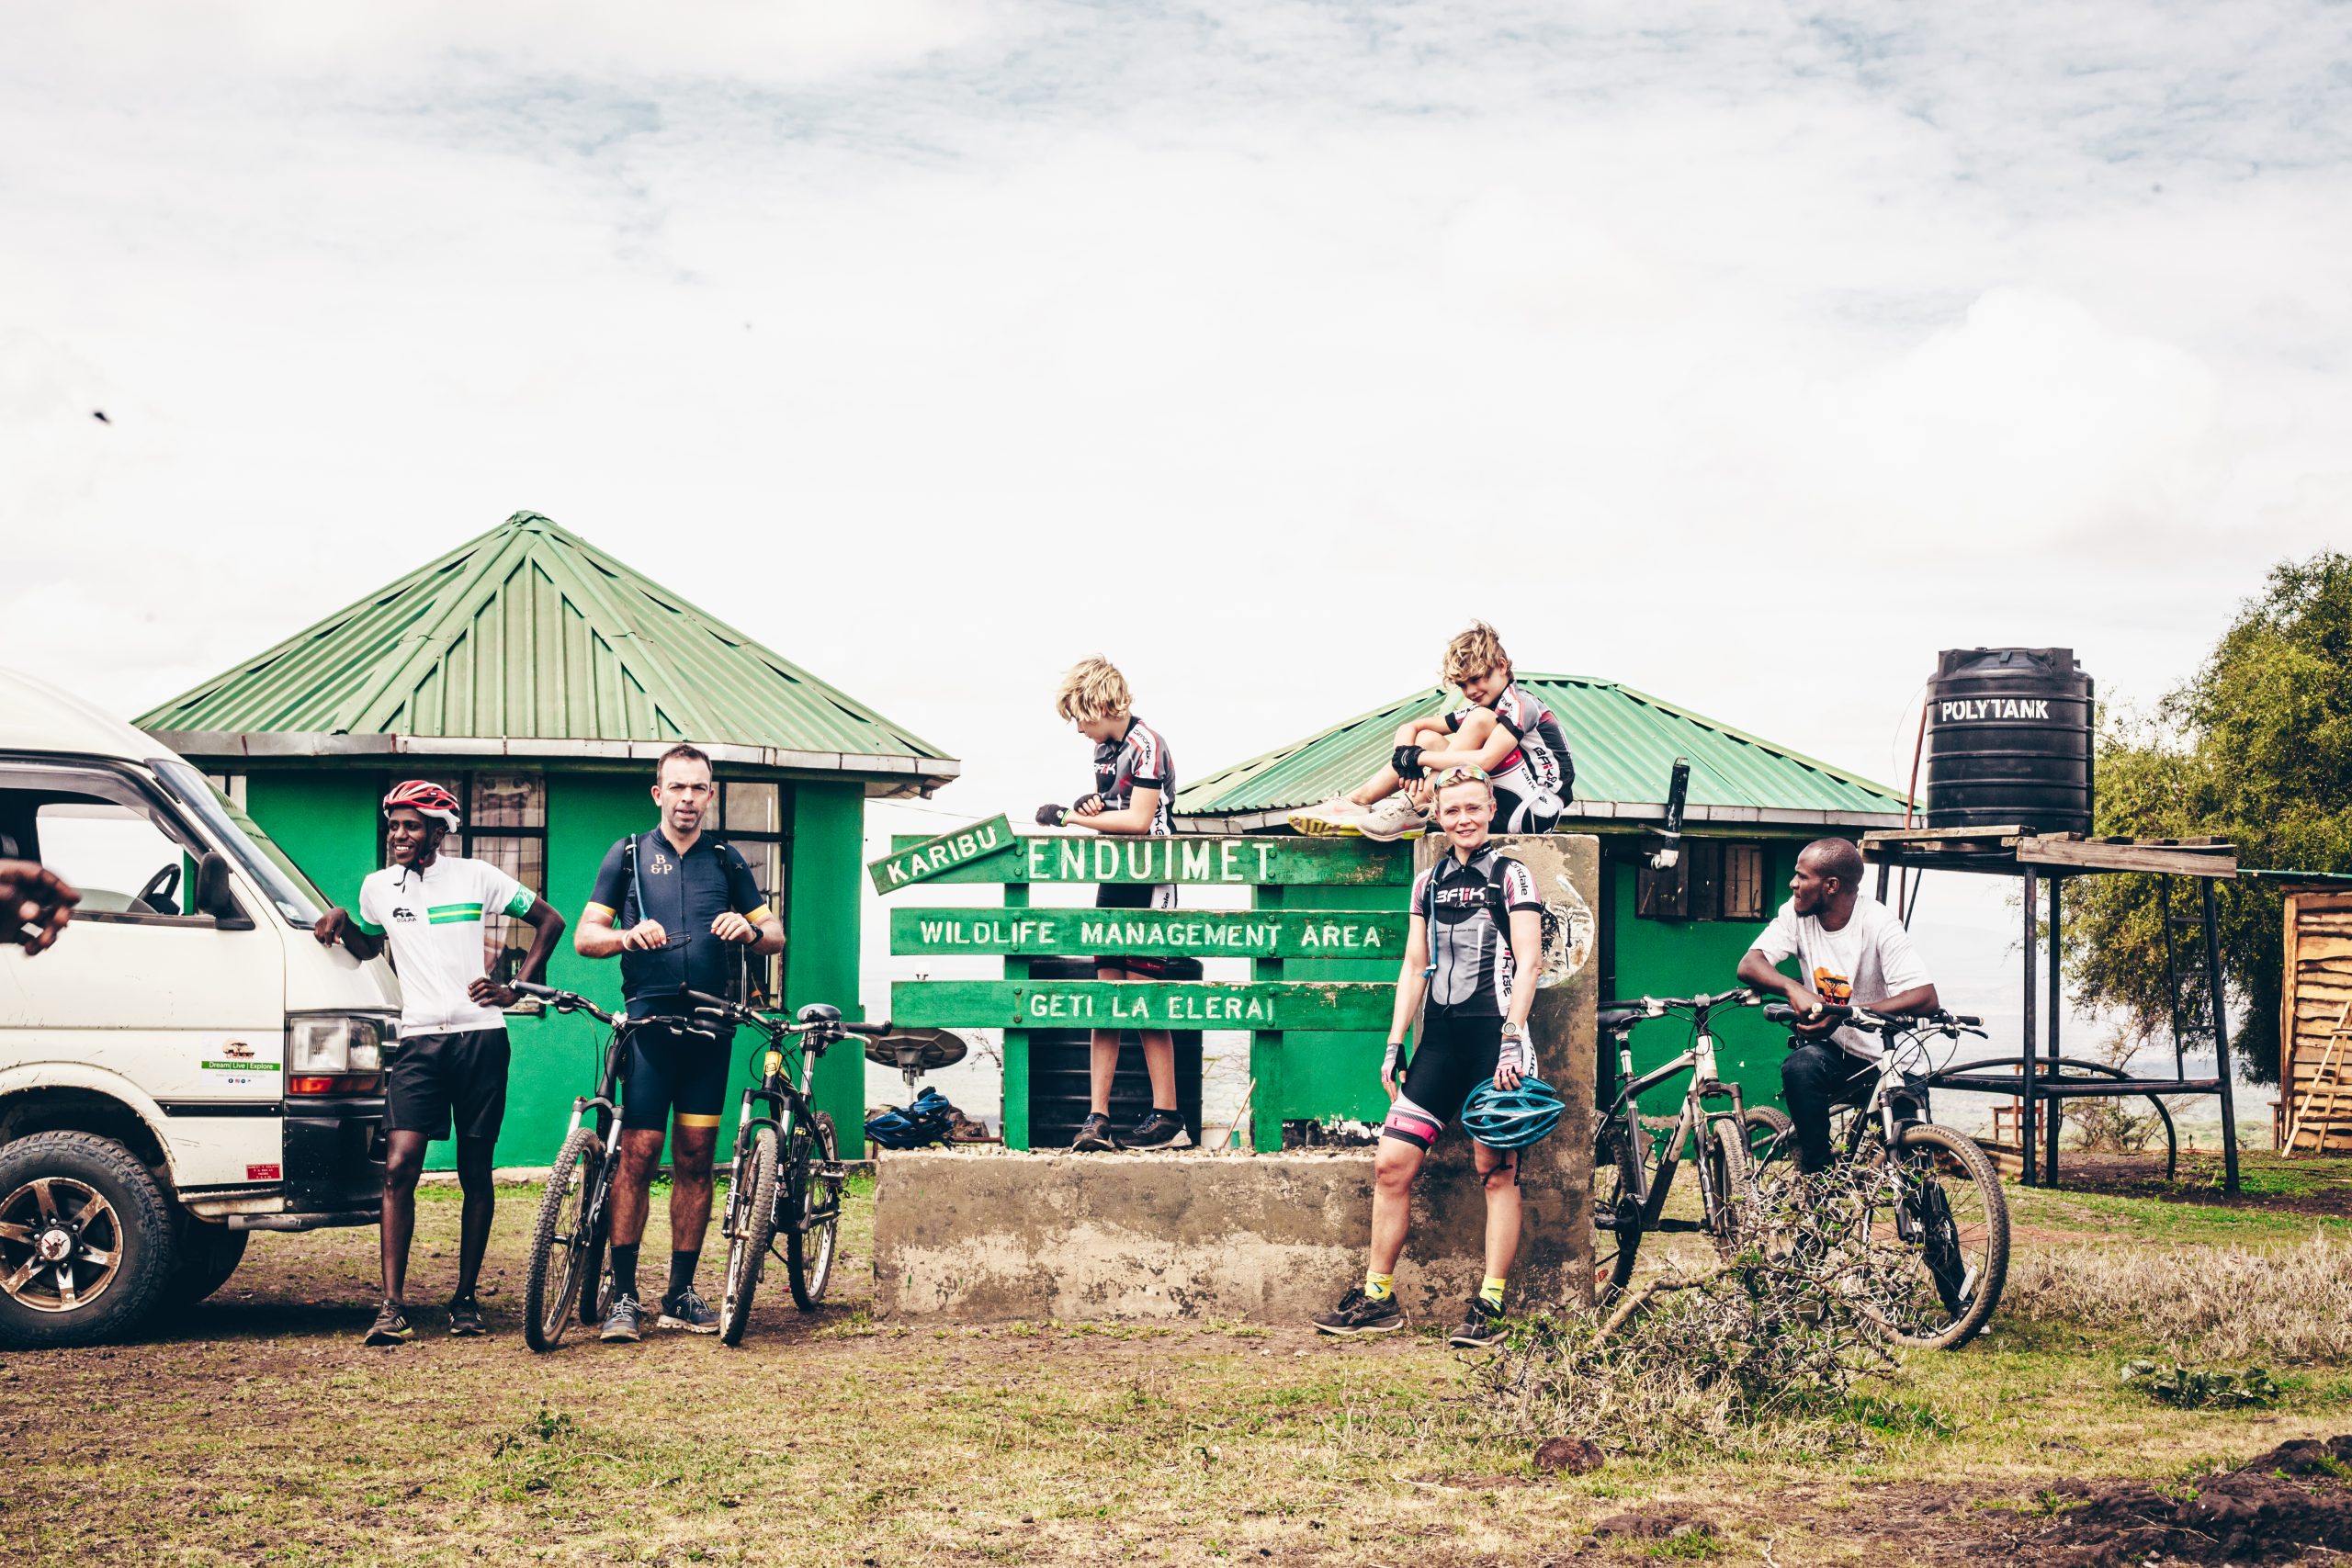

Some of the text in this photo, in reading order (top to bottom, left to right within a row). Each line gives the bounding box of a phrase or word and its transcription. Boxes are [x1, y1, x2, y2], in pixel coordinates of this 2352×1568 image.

[1941, 699, 2049, 722] POLYTANK
[655, 854, 666, 864] B
[886, 825, 999, 885] KARIBU
[1028, 839, 1276, 881] ENDUIMET
[920, 921, 1381, 949] WILDLIFE MANAGEMENT AREA
[1030, 995, 1274, 1021] GETI LA ELERAI
[249, 1063, 274, 1071] Explore
